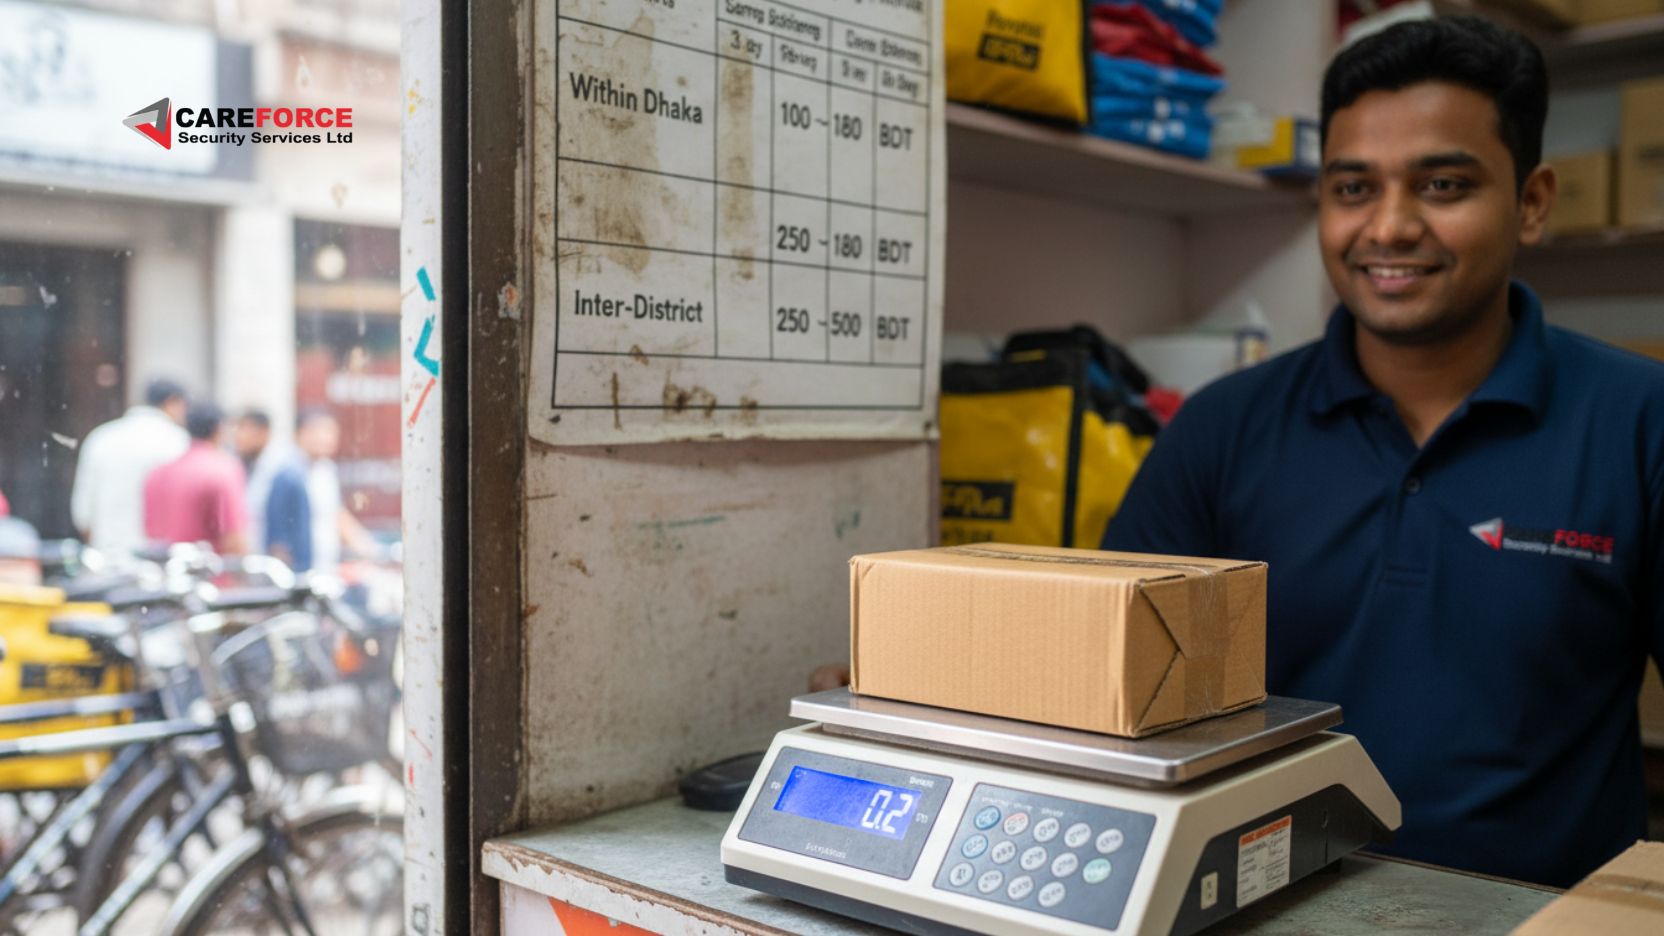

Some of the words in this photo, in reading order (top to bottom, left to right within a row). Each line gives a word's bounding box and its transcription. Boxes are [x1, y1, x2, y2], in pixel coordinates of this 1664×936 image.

[569, 72, 638, 112] Within
[644, 89, 704, 125] Dhaka
[780, 101, 811, 130] 100
[833, 114, 863, 141] 180
[879, 123, 913, 151] BDT
[776, 225, 810, 253] 250
[833, 233, 863, 260] 180
[878, 238, 912, 264] BDT
[571, 290, 704, 323] Inter-District
[776, 308, 810, 334] 250
[831, 312, 862, 338] 500
[877, 316, 911, 340] BDT
[861, 789, 913, 834] 0.2
